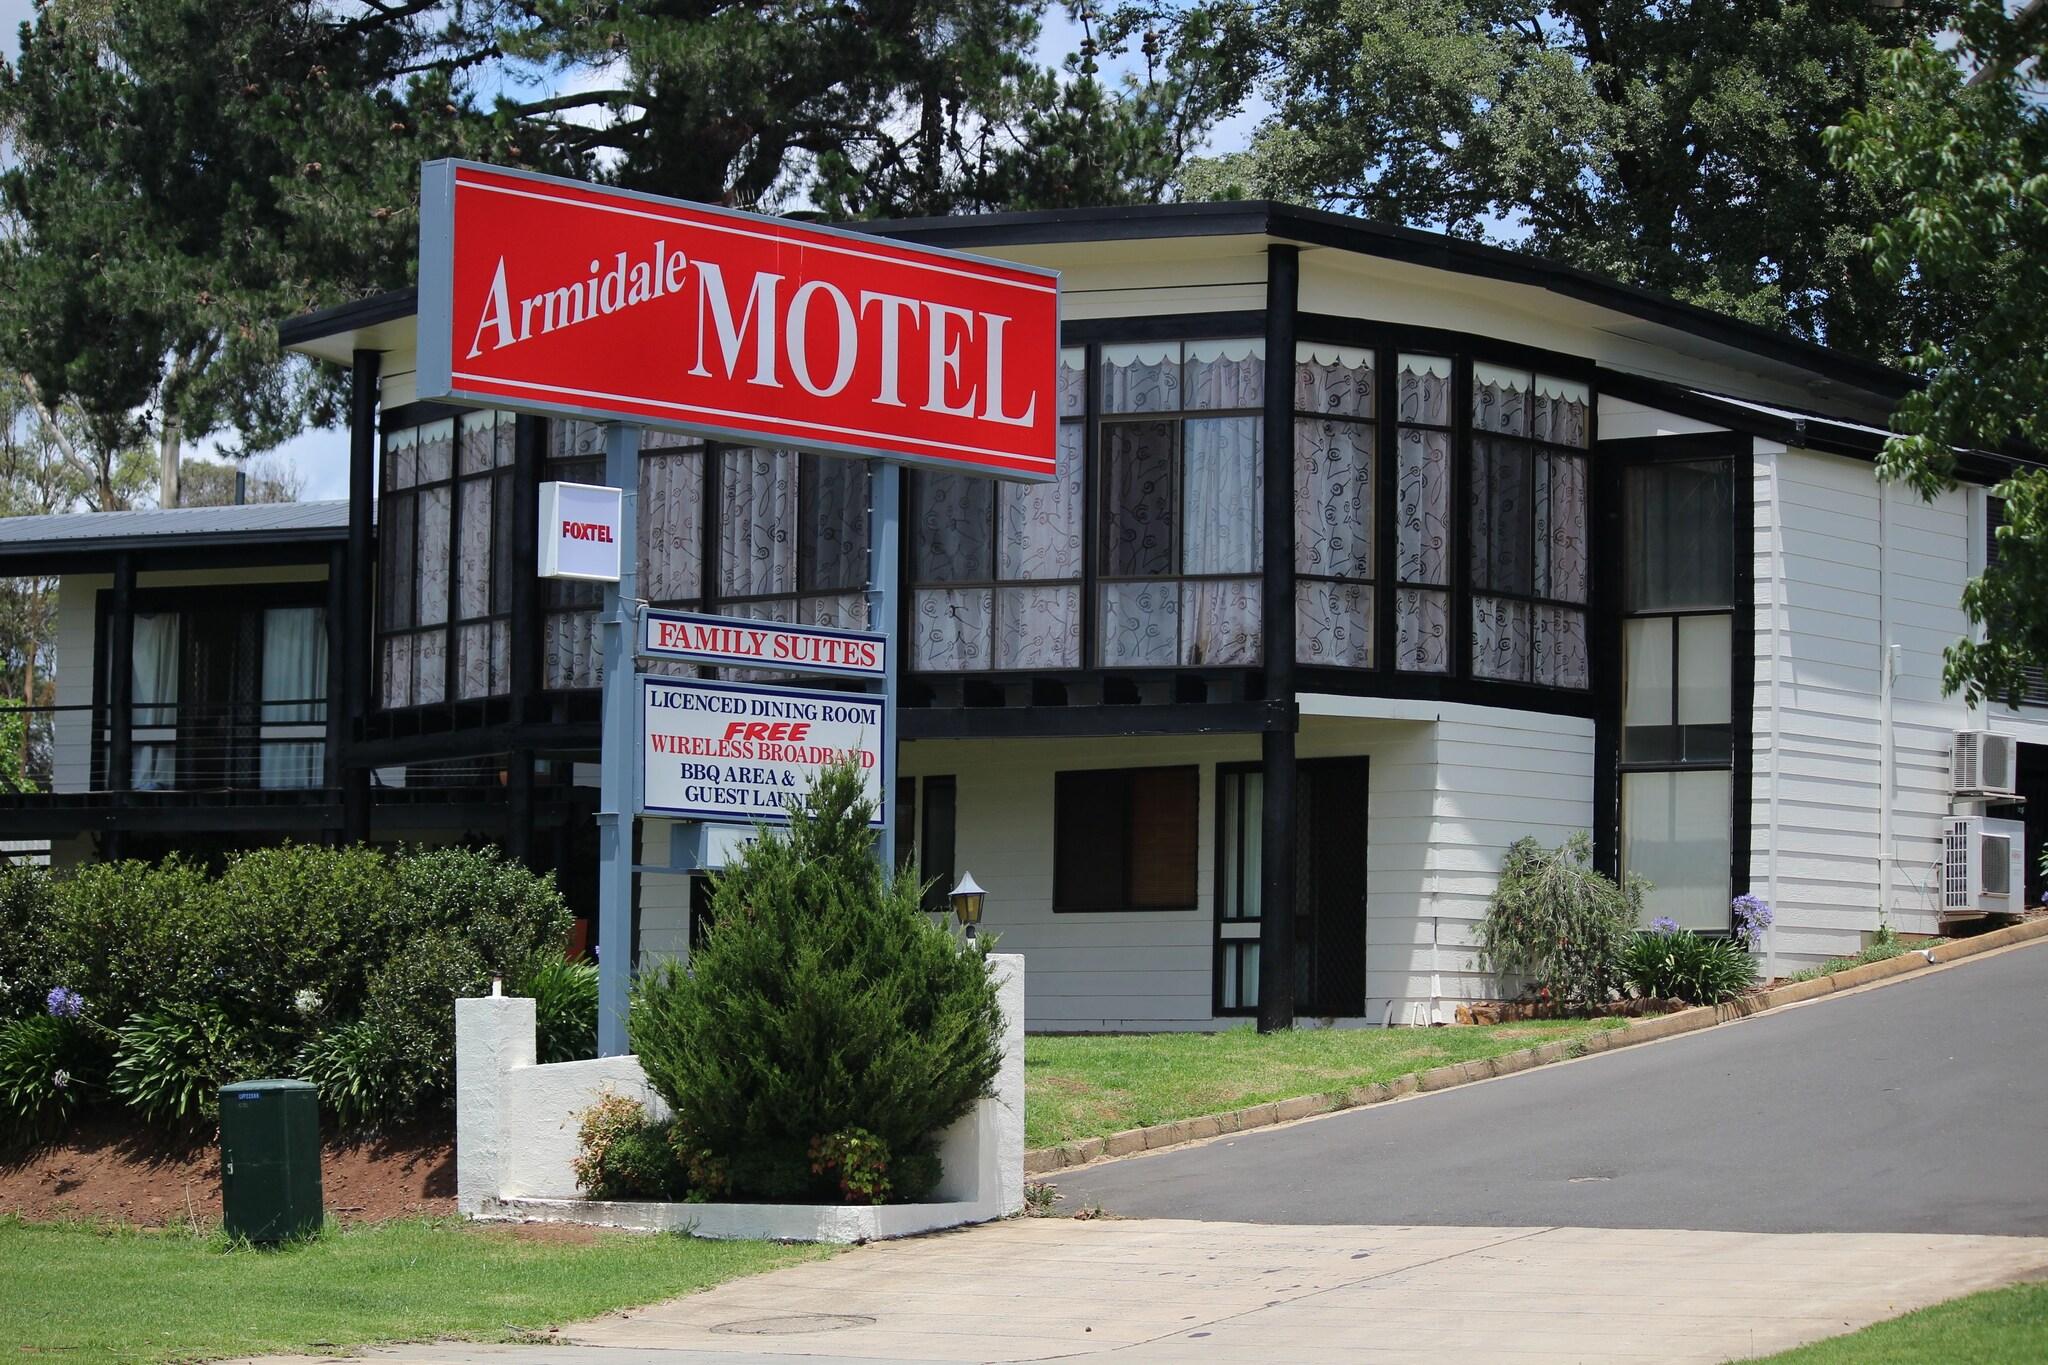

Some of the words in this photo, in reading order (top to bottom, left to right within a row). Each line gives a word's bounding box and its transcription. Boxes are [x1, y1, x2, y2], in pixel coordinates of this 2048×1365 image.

[466, 240, 687, 360] Armidale
[687, 259, 1036, 428] MOTEL
[562, 521, 613, 544] FOXTEL
[658, 622, 767, 656] FAMILY
[772, 634, 876, 666] SUITES
[650, 690, 746, 715] LICENCED
[750, 699, 817, 720] DINING
[821, 705, 876, 725] ROOM
[723, 722, 811, 741] FREE
[651, 735, 754, 759] WIRELESS
[680, 762, 720, 785] BBQ
[724, 766, 778, 786] AREA
[781, 769, 795, 787] &
[684, 785, 750, 806] GUEST
